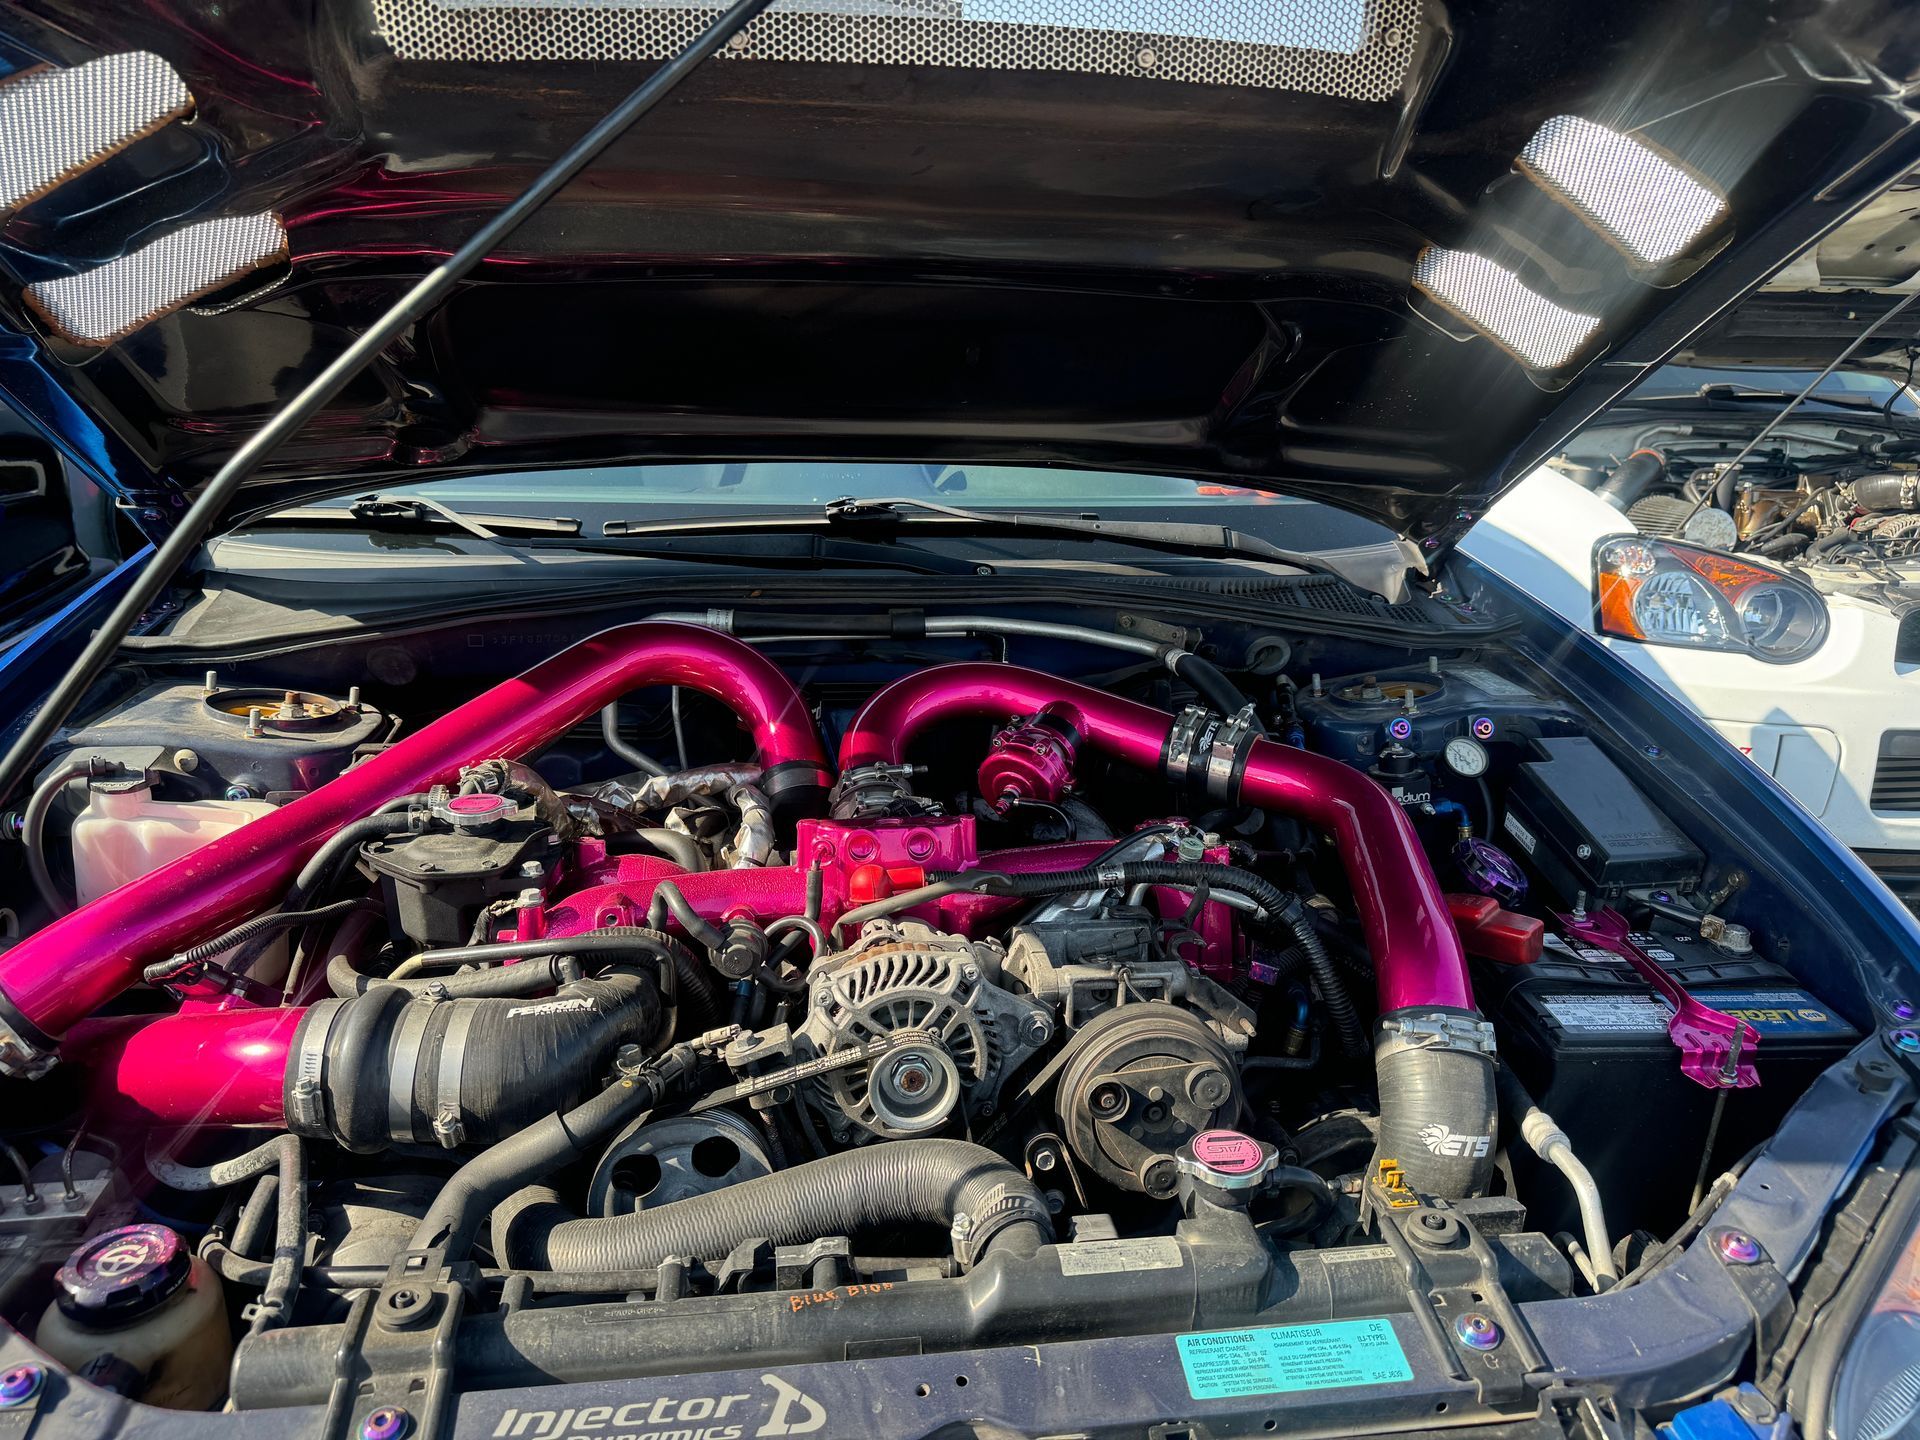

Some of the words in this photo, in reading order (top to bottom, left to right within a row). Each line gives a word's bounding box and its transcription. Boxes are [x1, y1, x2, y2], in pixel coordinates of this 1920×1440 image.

[1205, 721, 1220, 742] ETS
[1393, 791, 1430, 803] adium
[506, 997, 595, 1018] PERRIN
[535, 1007, 598, 1016] PERFORMANCE
[1718, 1009, 1799, 1021] LEGE
[1441, 1133, 1490, 1157] ETS
[1188, 1339, 1200, 1347] AIR
[1202, 1334, 1255, 1346] CONDITIONER
[1271, 1329, 1322, 1340] CLIMATISEUR
[1189, 1347, 1225, 1355] REFRIGERANT
[1373, 1371, 1387, 1379] SAE
[492, 1393, 751, 1440] Injector
